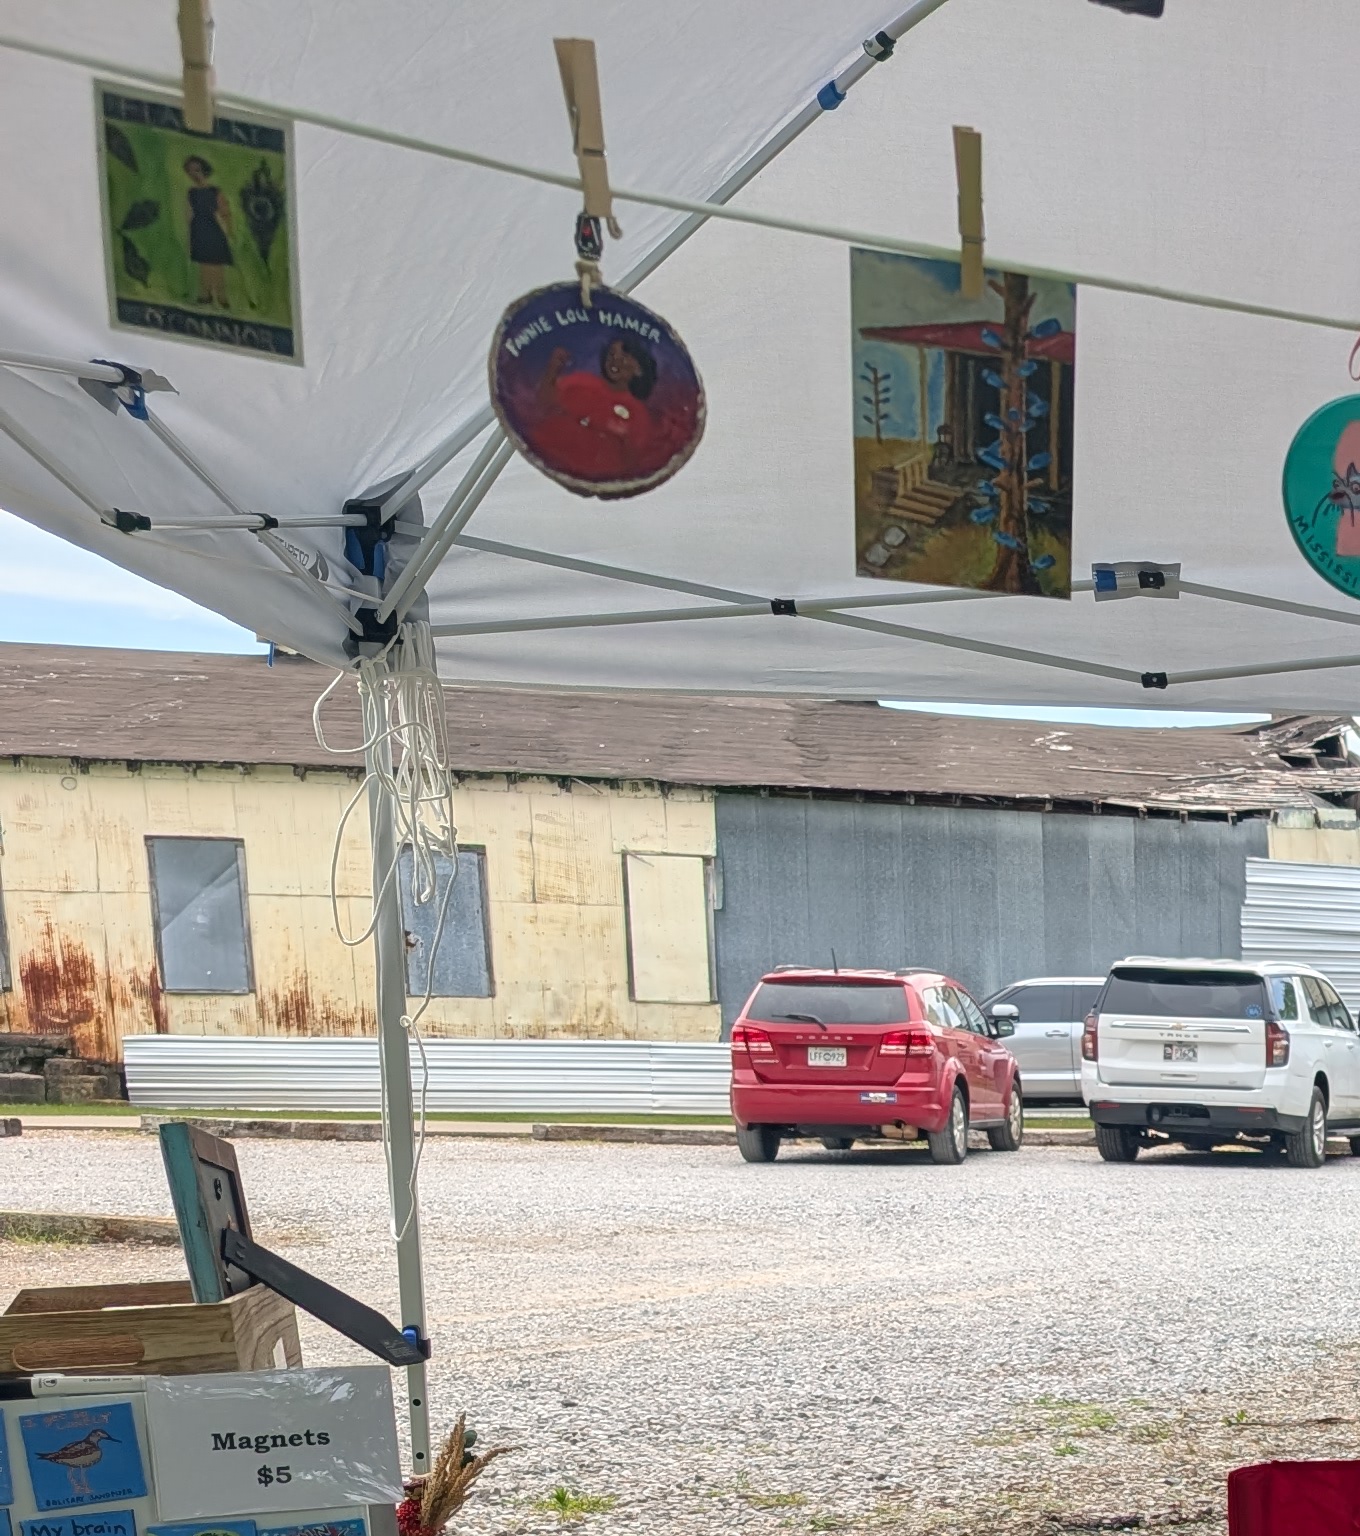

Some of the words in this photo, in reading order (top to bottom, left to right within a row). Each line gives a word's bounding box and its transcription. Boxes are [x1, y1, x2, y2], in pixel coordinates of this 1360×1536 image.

[505, 316, 552, 357] FANNIE
[555, 308, 590, 326] LOU
[598, 310, 661, 343] HAMER
[211, 1429, 331, 1454] Magnets
[257, 1464, 292, 1487] $5
[71, 1519, 127, 1536] brain
